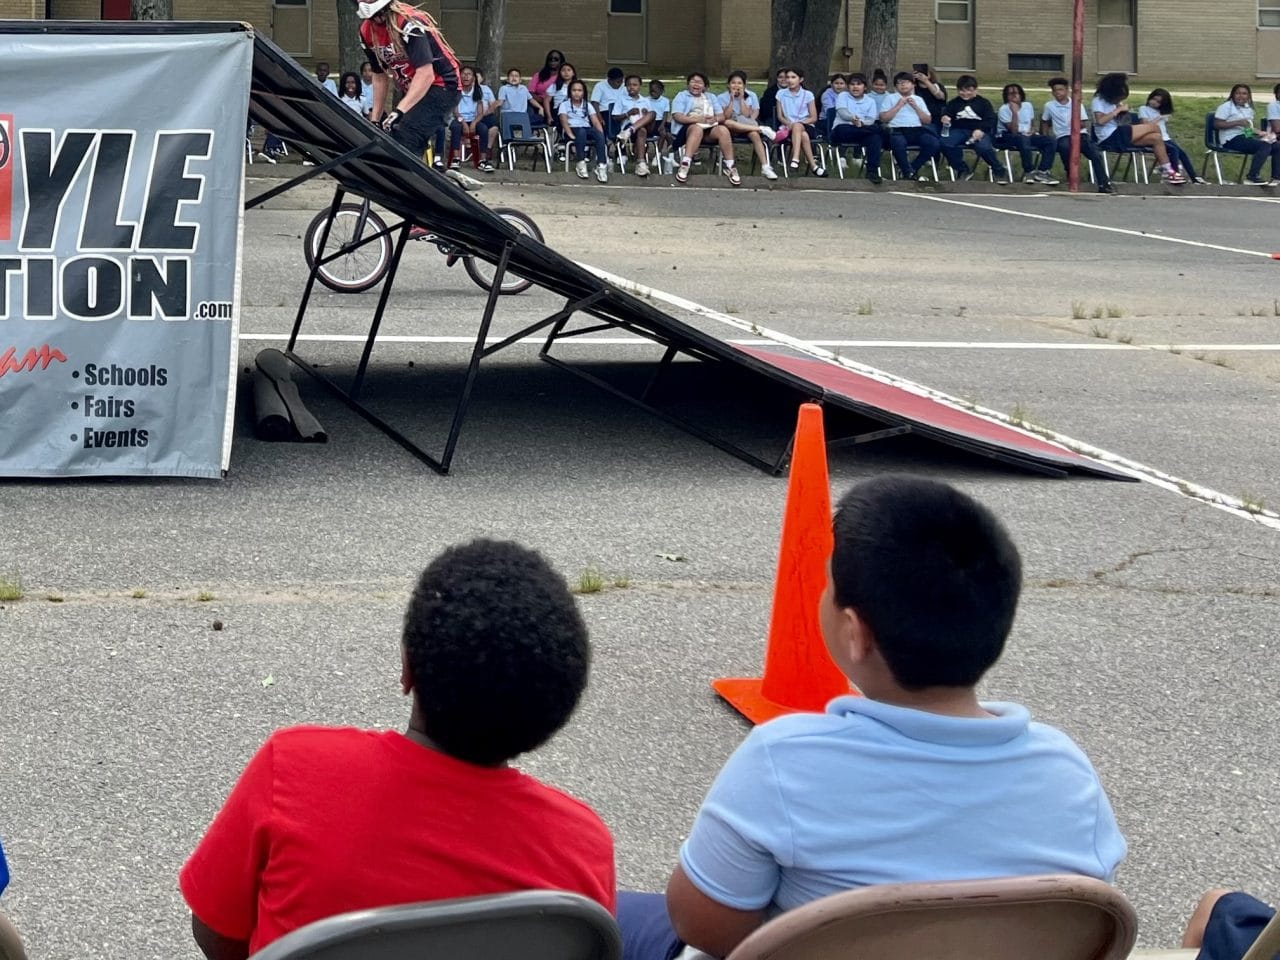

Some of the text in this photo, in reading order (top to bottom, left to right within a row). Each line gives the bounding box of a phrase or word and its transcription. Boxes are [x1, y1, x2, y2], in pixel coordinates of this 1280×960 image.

[84, 363, 168, 386] Schools
[84, 395, 135, 418] Fairs
[83, 427, 149, 449] Events
